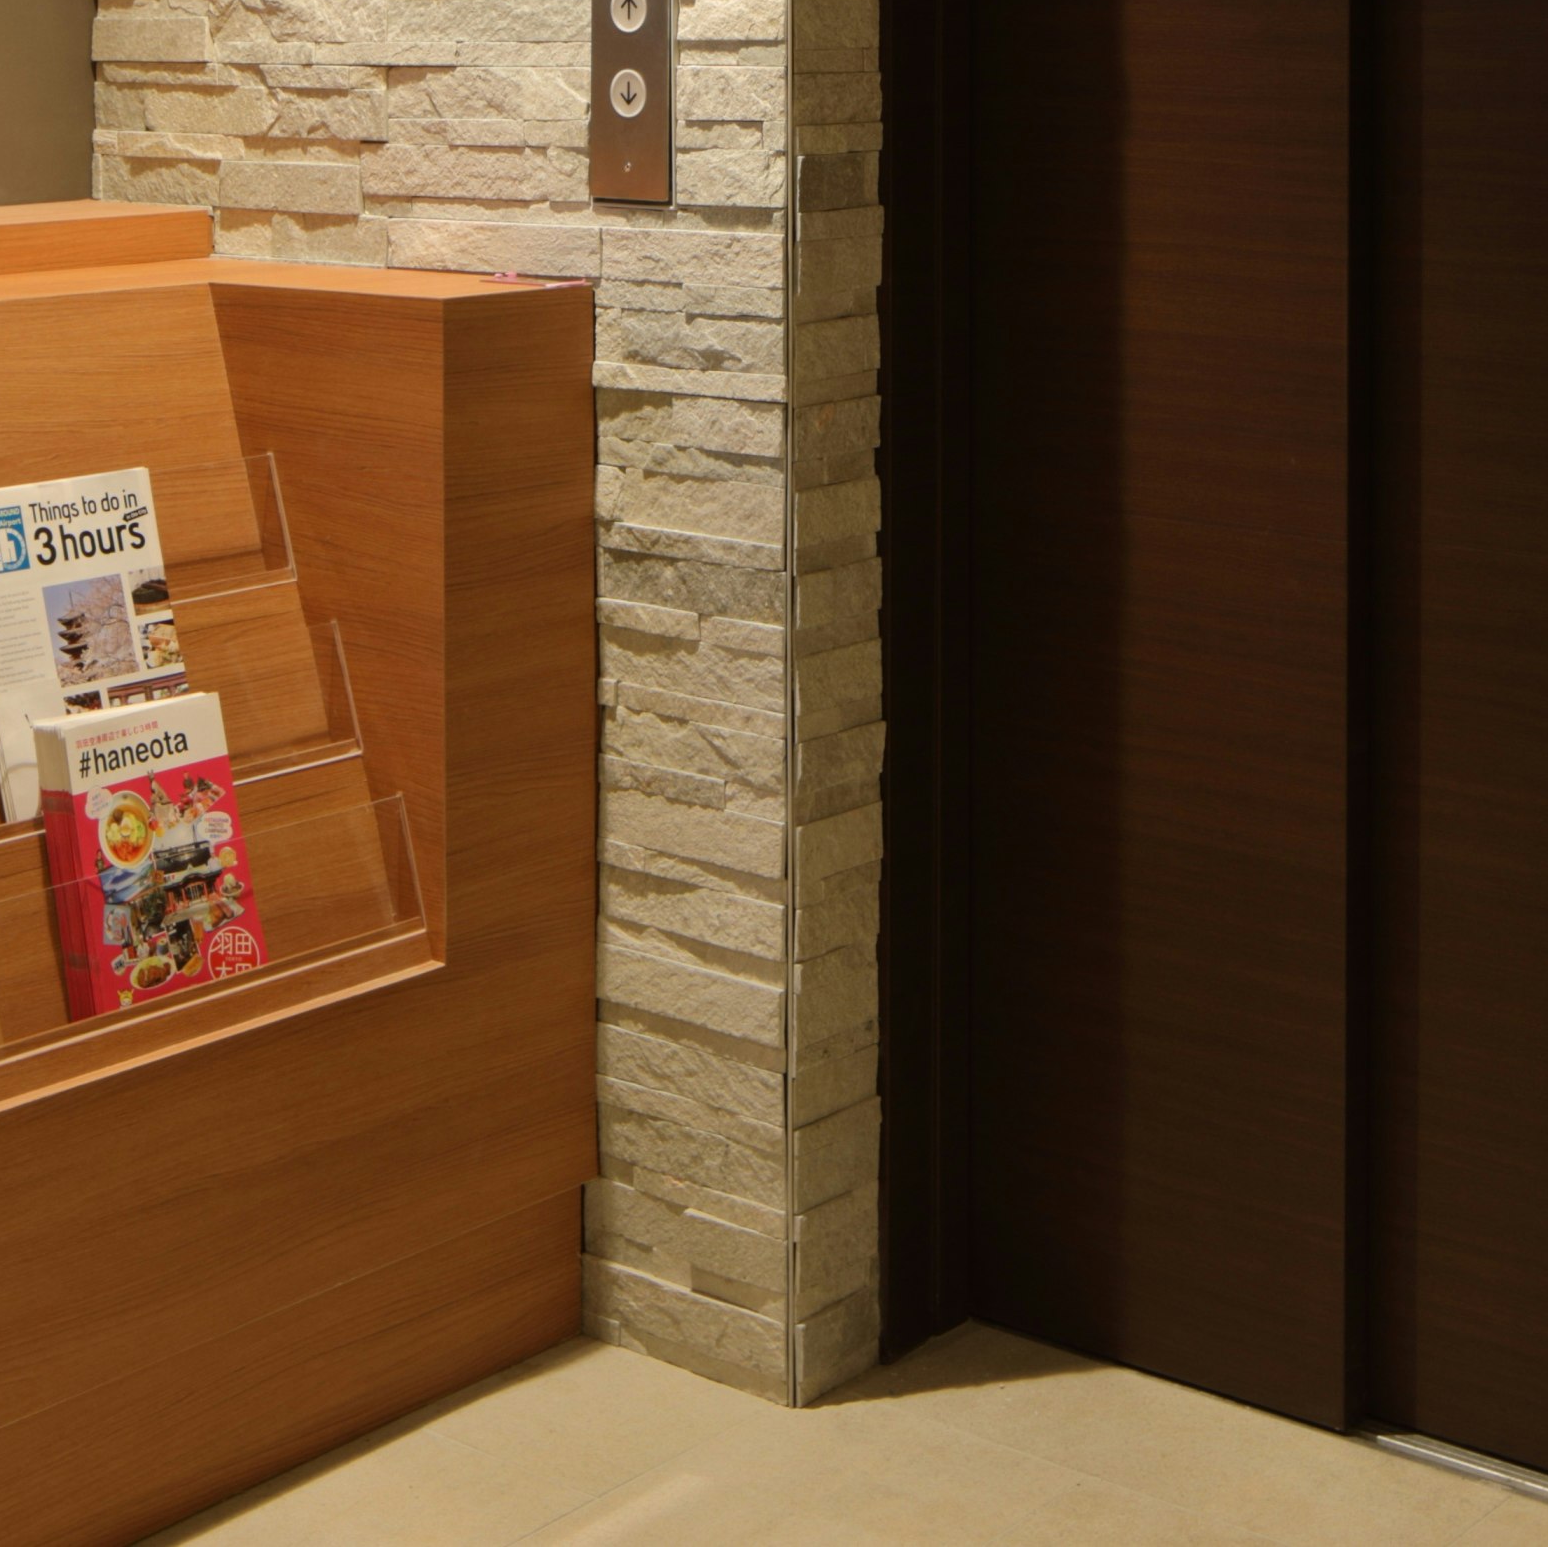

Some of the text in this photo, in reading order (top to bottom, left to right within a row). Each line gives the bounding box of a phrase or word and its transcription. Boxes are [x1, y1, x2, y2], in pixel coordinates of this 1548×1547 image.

[28, 489, 138, 523] Things to do in
[33, 521, 146, 566] 3 hours
[79, 730, 189, 779] #haneota
[210, 932, 252, 955] 羽田
